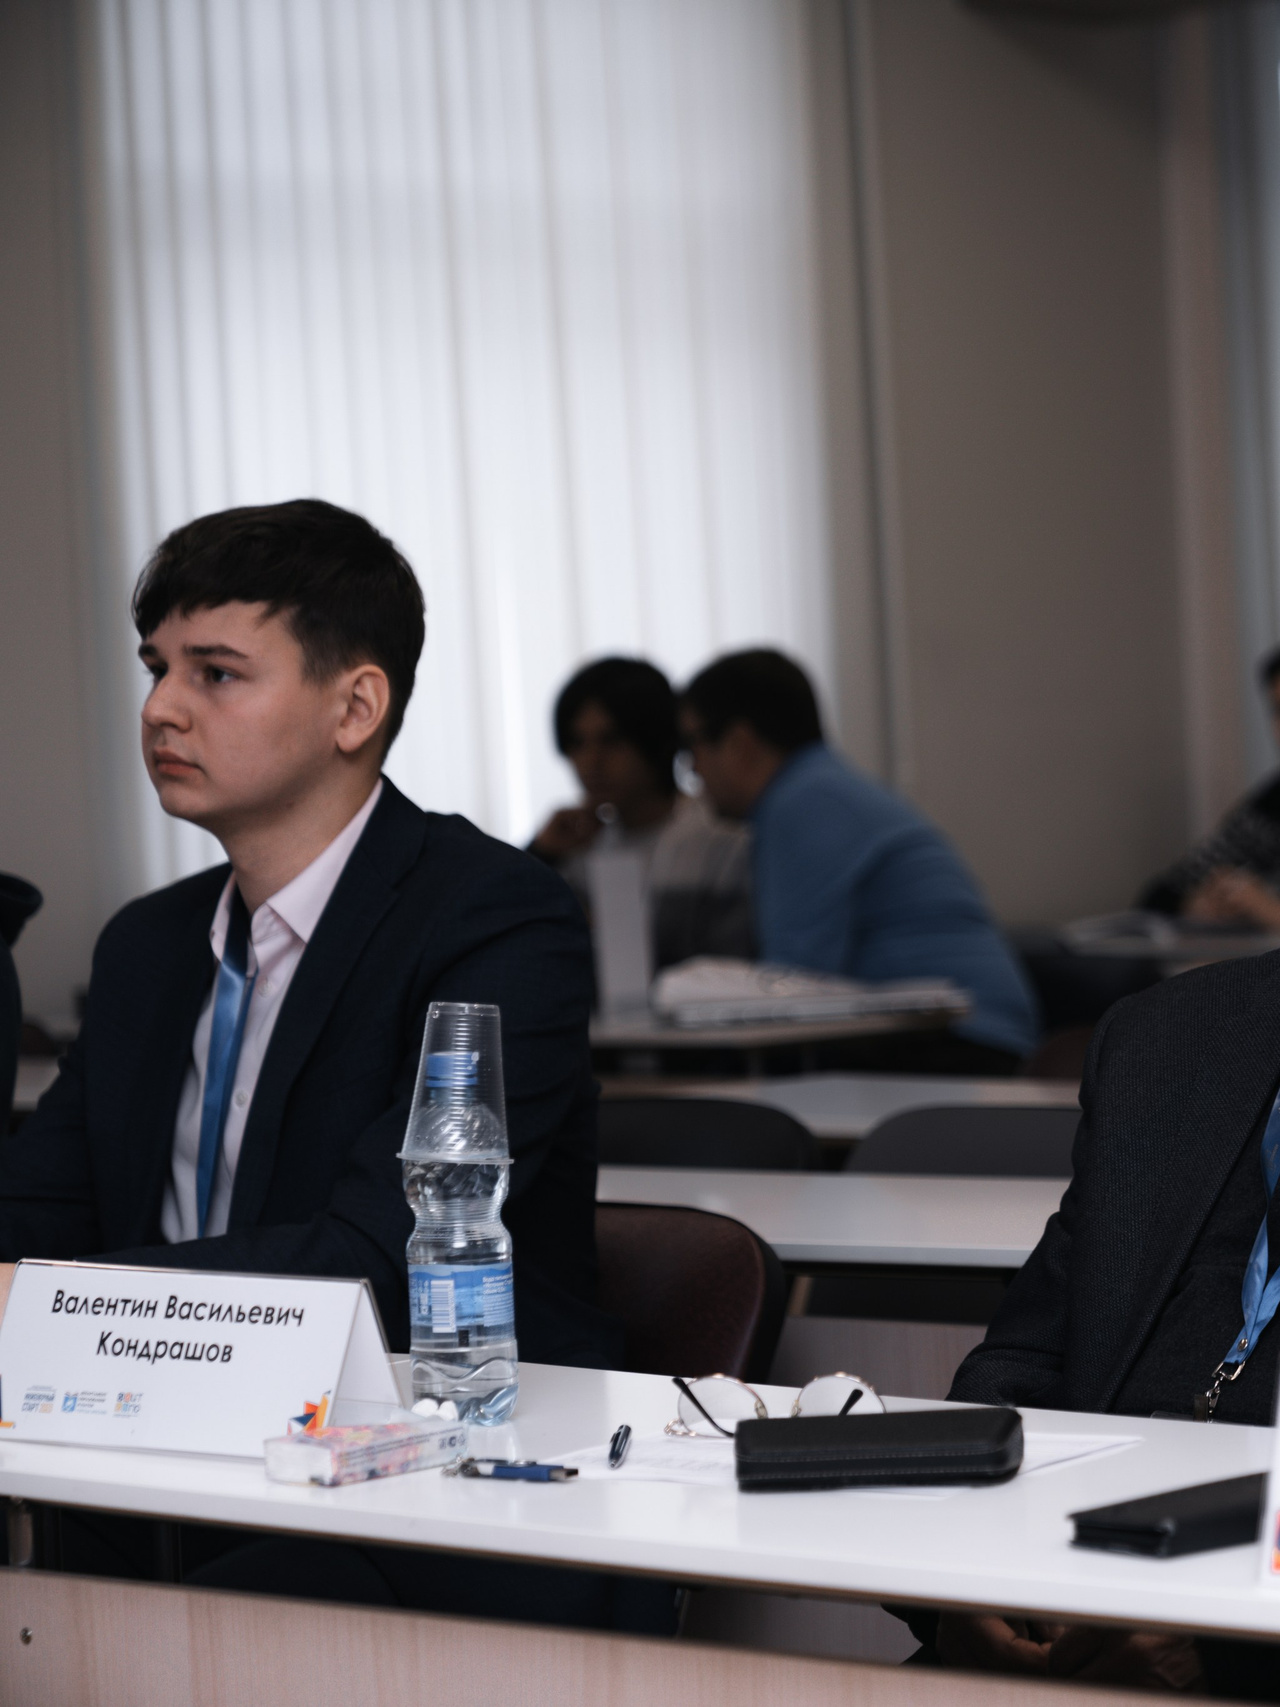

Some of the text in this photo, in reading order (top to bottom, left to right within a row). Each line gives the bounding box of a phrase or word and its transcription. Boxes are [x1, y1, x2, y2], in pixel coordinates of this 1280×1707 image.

[51, 1289, 305, 1326] Валентин Васильевич
[96, 1331, 233, 1364] Кондрашов
